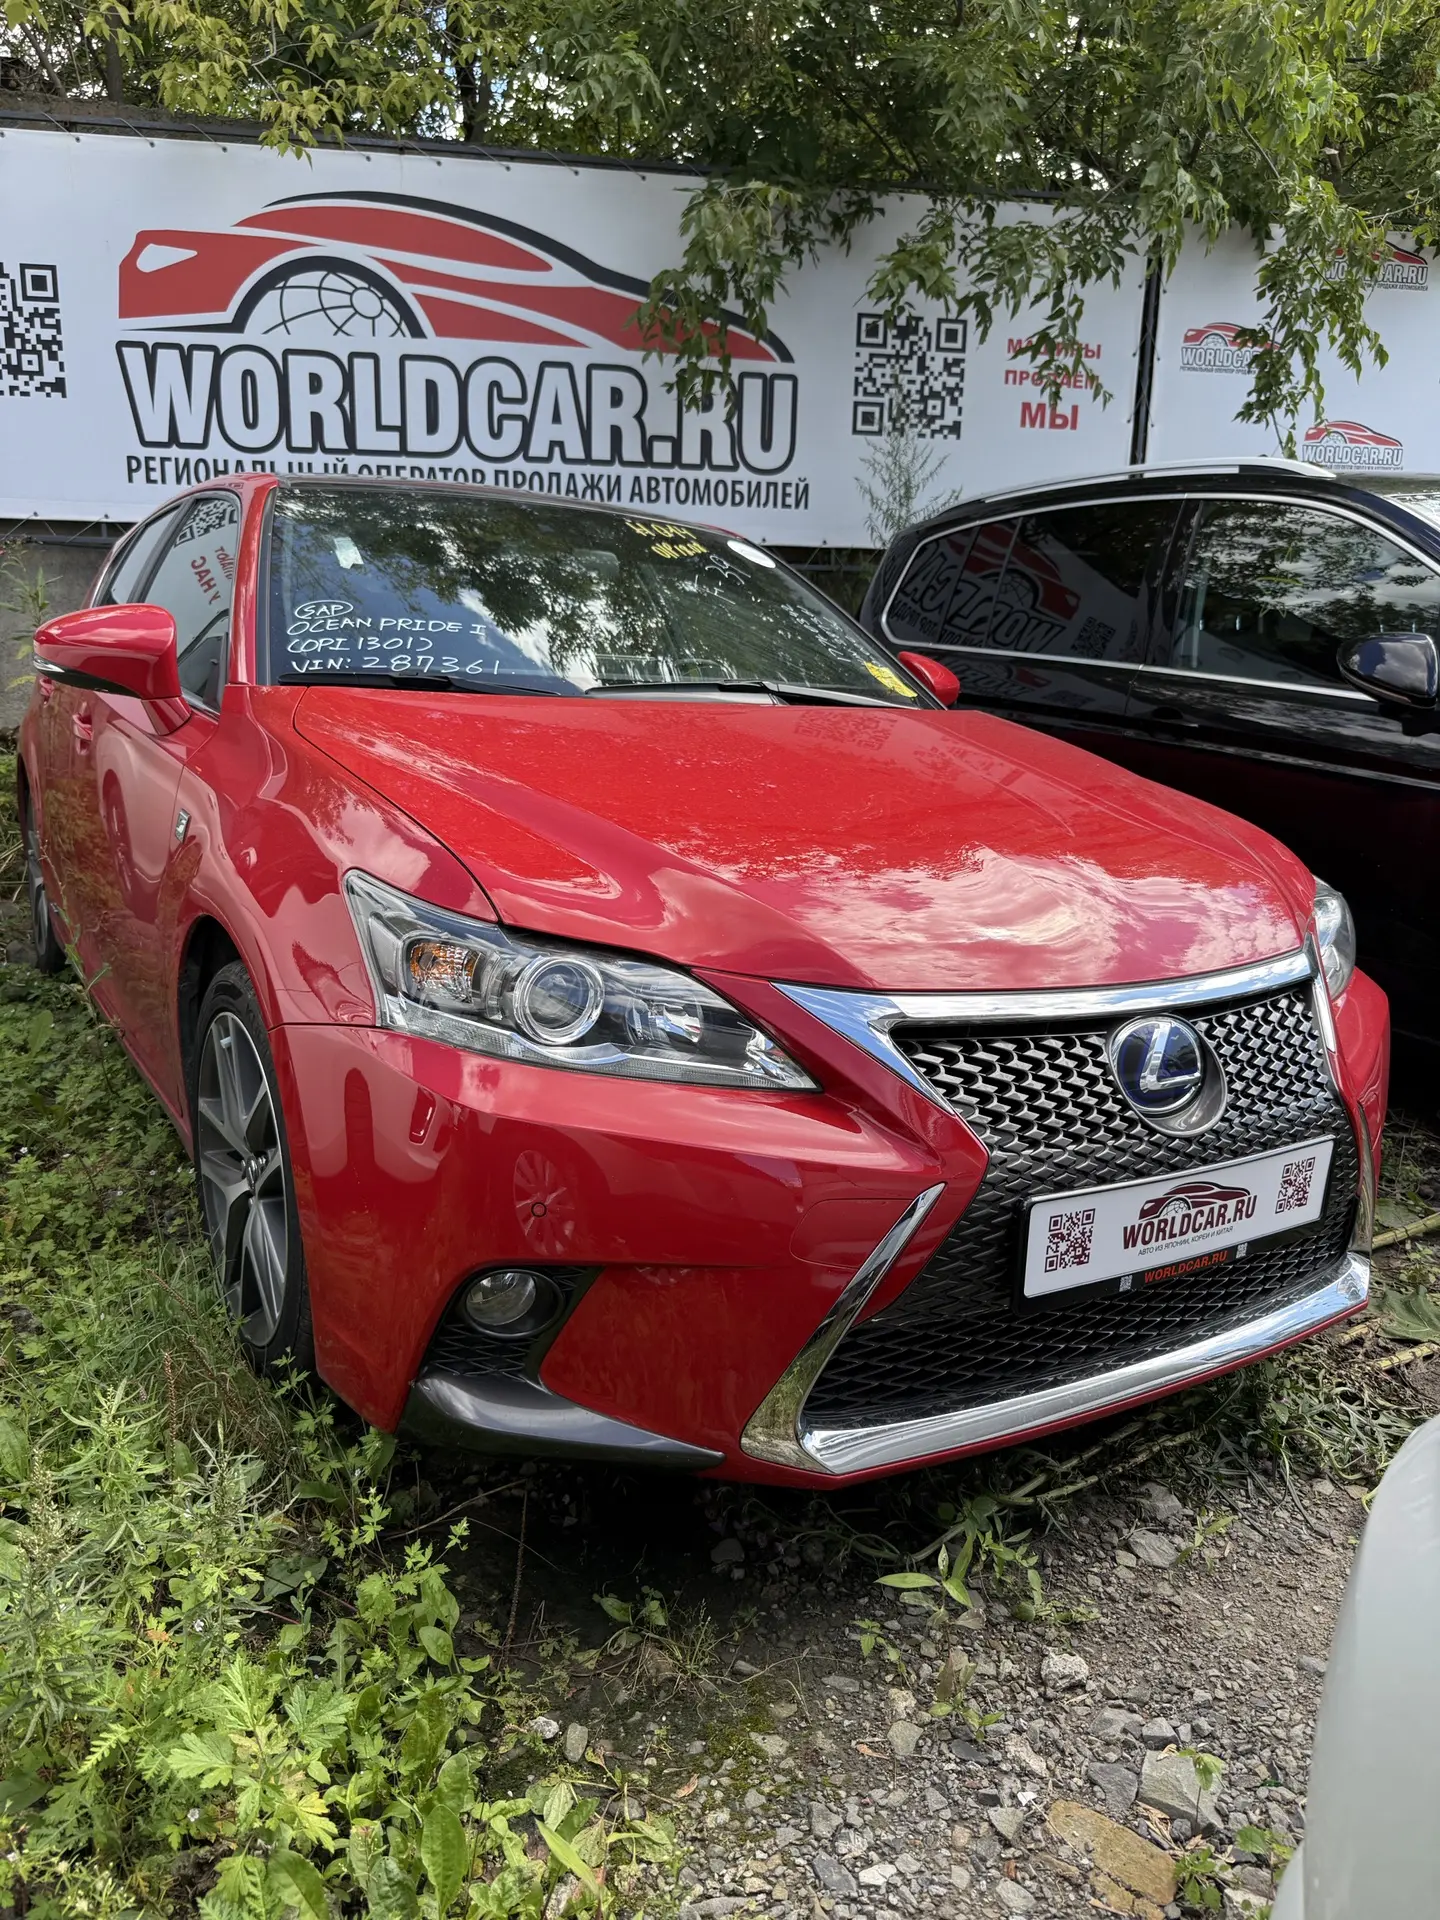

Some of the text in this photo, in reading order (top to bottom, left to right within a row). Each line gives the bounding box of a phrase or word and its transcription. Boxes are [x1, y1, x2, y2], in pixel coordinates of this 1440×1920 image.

[116, 341, 799, 475] WORLDCAR.RU
[1020, 402, 1079, 430] МЫ
[1302, 444, 1403, 466] WORLDCAR.RU
[629, 475, 810, 510] АВТОМОБИЛЕЙ
[287, 617, 371, 635] OCEAN
[380, 617, 463, 633] PRIDE
[291, 657, 351, 674] VIN:
[1122, 1195, 1258, 1250] WORLDCAR.RU
[1137, 1246, 1155, 1256] АВТО
[1155, 1244, 1164, 1252] ИЗ
[1144, 1250, 1229, 1284] WORLDCAR.RU
